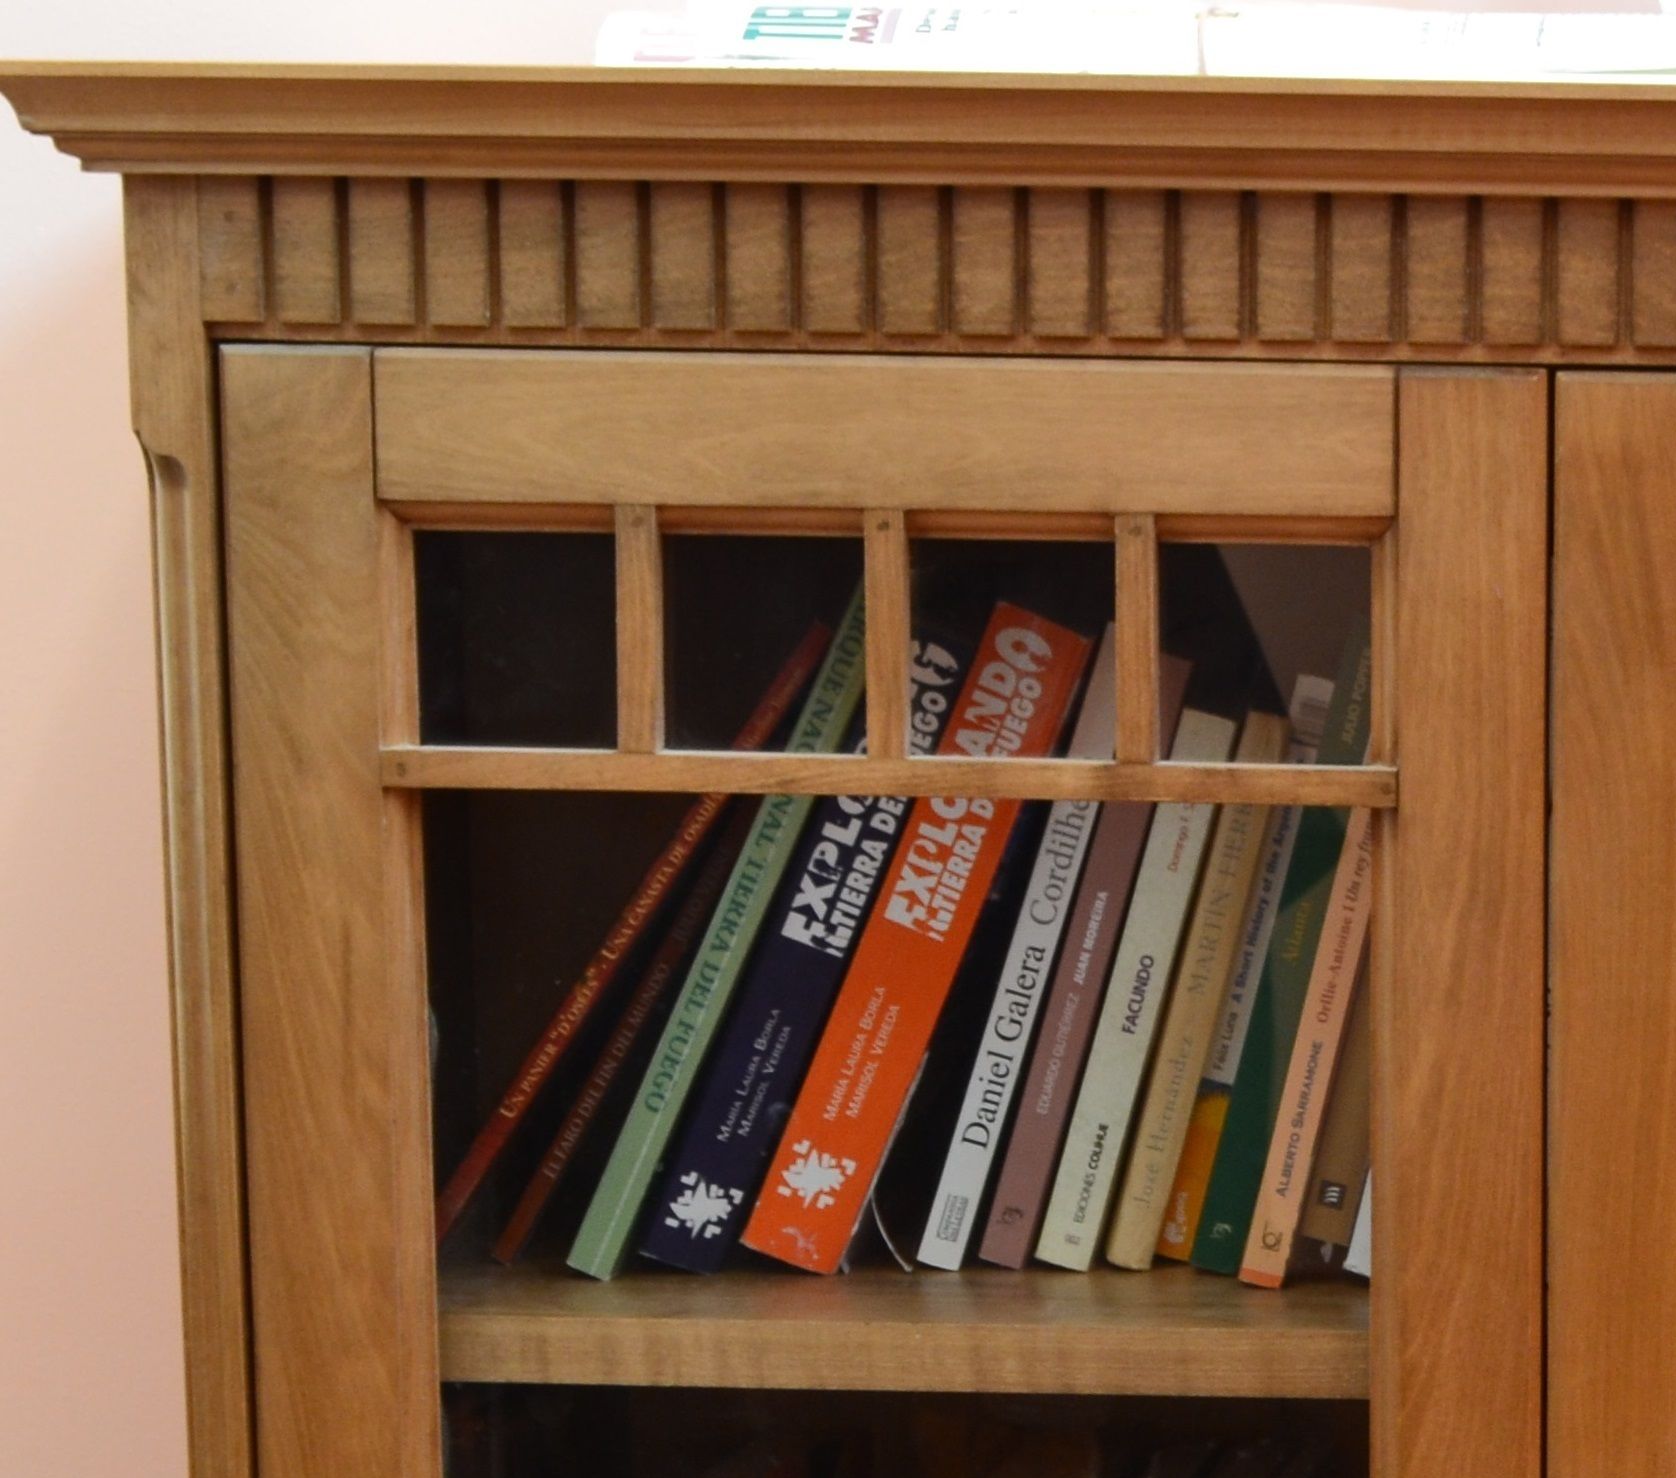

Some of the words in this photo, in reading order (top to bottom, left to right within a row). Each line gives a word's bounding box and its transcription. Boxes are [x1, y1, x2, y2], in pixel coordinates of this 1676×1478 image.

[708, 856, 766, 956] TIERRA
[828, 832, 890, 931] TIERRA
[929, 820, 987, 914] TIERRA
[517, 1040, 558, 1092] PANIER
[599, 922, 634, 962] UNA
[625, 863, 674, 927] CANASTA
[623, 960, 673, 1028] MUNDO
[682, 957, 722, 1018] DEL
[1035, 1057, 1062, 1115] EDUARDO
[1072, 951, 1091, 985] JUAN
[1082, 890, 1109, 951] MOREIRA
[1119, 952, 1157, 1035] FACUNDO
[642, 1018, 697, 1115] FUEGO
[735, 1054, 761, 1096] LAURA
[753, 1007, 781, 1051] BORLA
[735, 1078, 769, 1137] MARISOL
[761, 1024, 792, 1074] VEREDA
[839, 1030, 867, 1077] LAURA
[857, 985, 886, 1031] BORLA
[843, 1057, 878, 1119] MARISOL
[868, 1003, 900, 1057] VEREDA
[959, 1046, 1013, 1151] Daniel
[989, 940, 1049, 1045] Galera
[1273, 1131, 1301, 1197] ALBERTO
[1290, 1039, 1324, 1129] SARRAMONE
